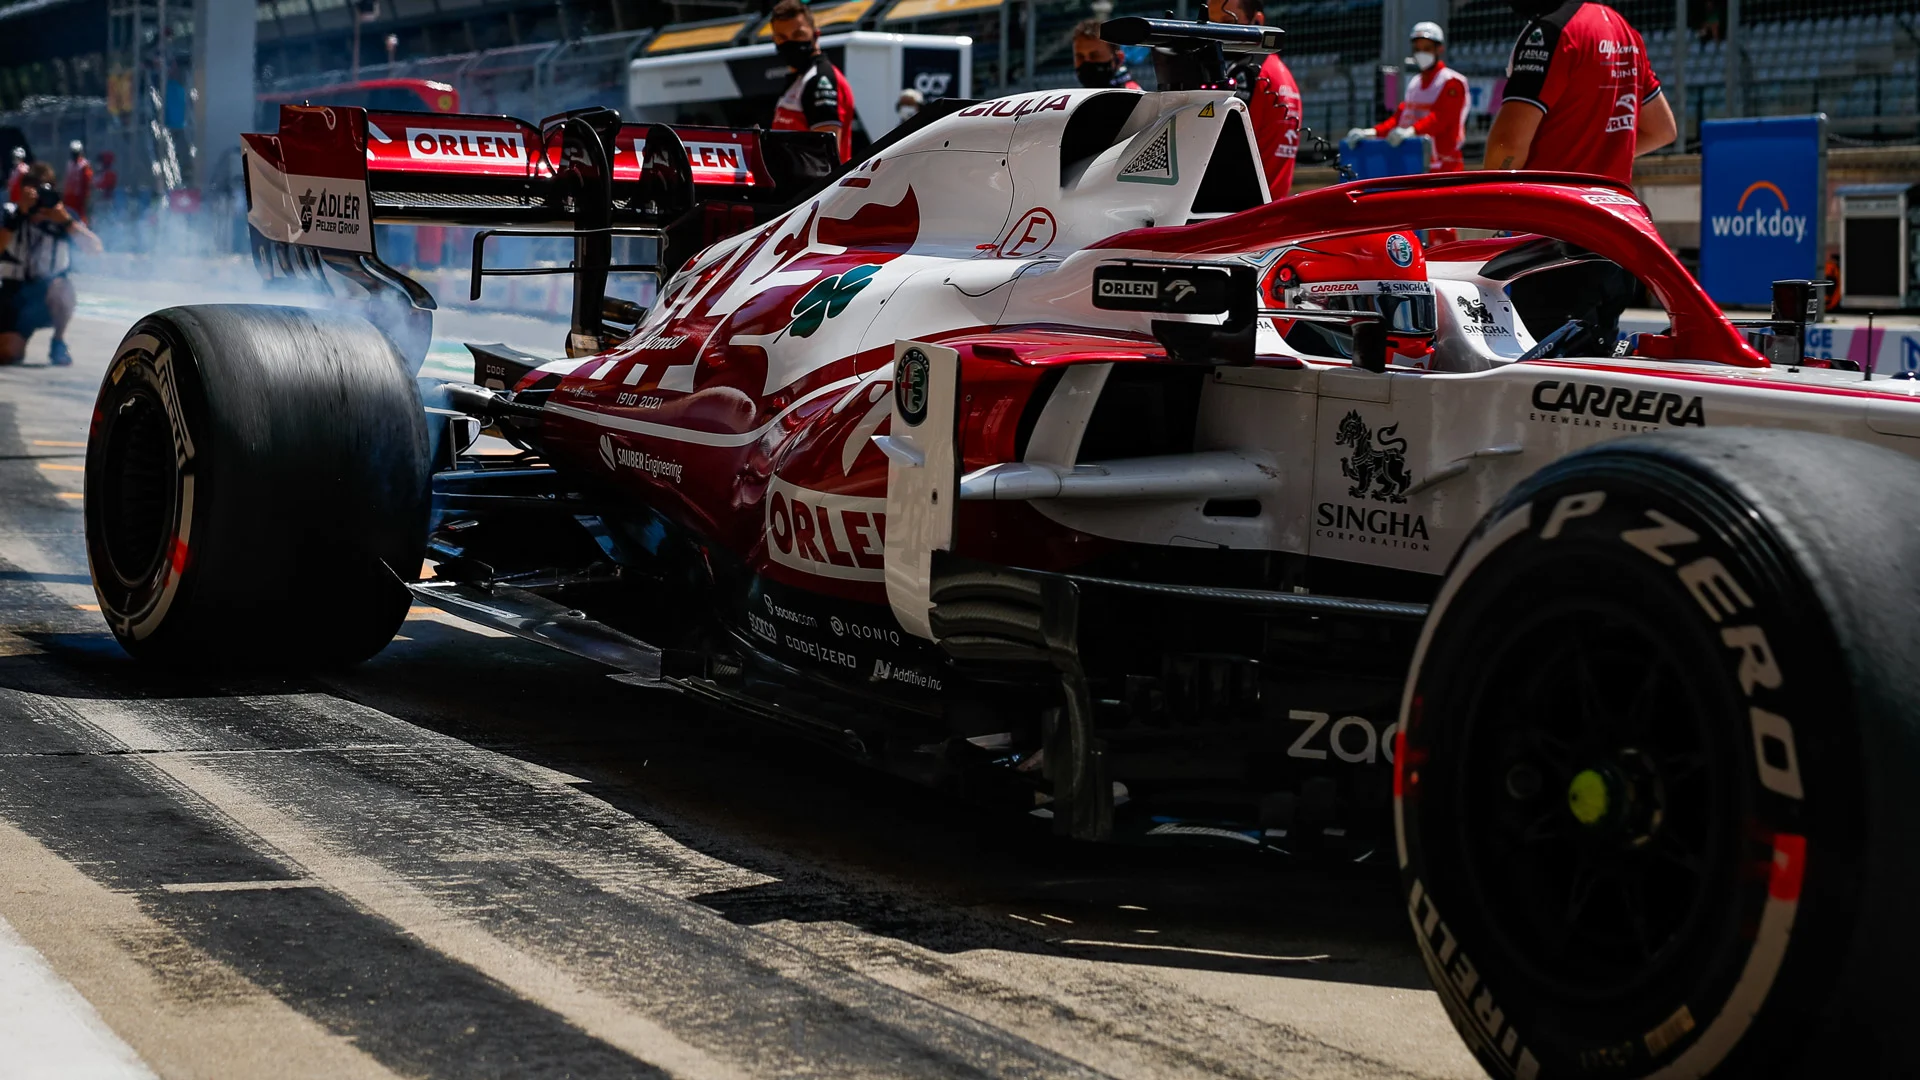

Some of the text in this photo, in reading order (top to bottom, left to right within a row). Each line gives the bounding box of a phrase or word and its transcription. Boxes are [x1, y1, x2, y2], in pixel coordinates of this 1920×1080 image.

[959, 95, 1071, 117] GIULIA
[414, 132, 518, 159] ORLEN
[689, 147, 740, 169] LEN
[317, 188, 360, 220] ADLER
[316, 219, 360, 235] PELZER GROUP
[1711, 208, 1807, 244] workday
[1101, 282, 1154, 297] ORLEN
[1310, 283, 1360, 293] CARRERA
[1392, 282, 1425, 292] SINGHA
[1463, 325, 1510, 334] SINGHA
[486, 364, 505, 376] CODE
[616, 392, 664, 410] 1910 2021
[1532, 380, 1706, 428] CARRERA
[1530, 413, 1601, 428] EYEWEAR
[617, 448, 683, 484] SAUBER Engineering
[769, 490, 888, 570] ORLE
[1317, 502, 1430, 540] SINGHA
[1316, 529, 1430, 552] CORPORATION
[846, 624, 900, 647] IQONIQ
[1540, 491, 1804, 800] P ZERO
[893, 667, 926, 687] Additive
